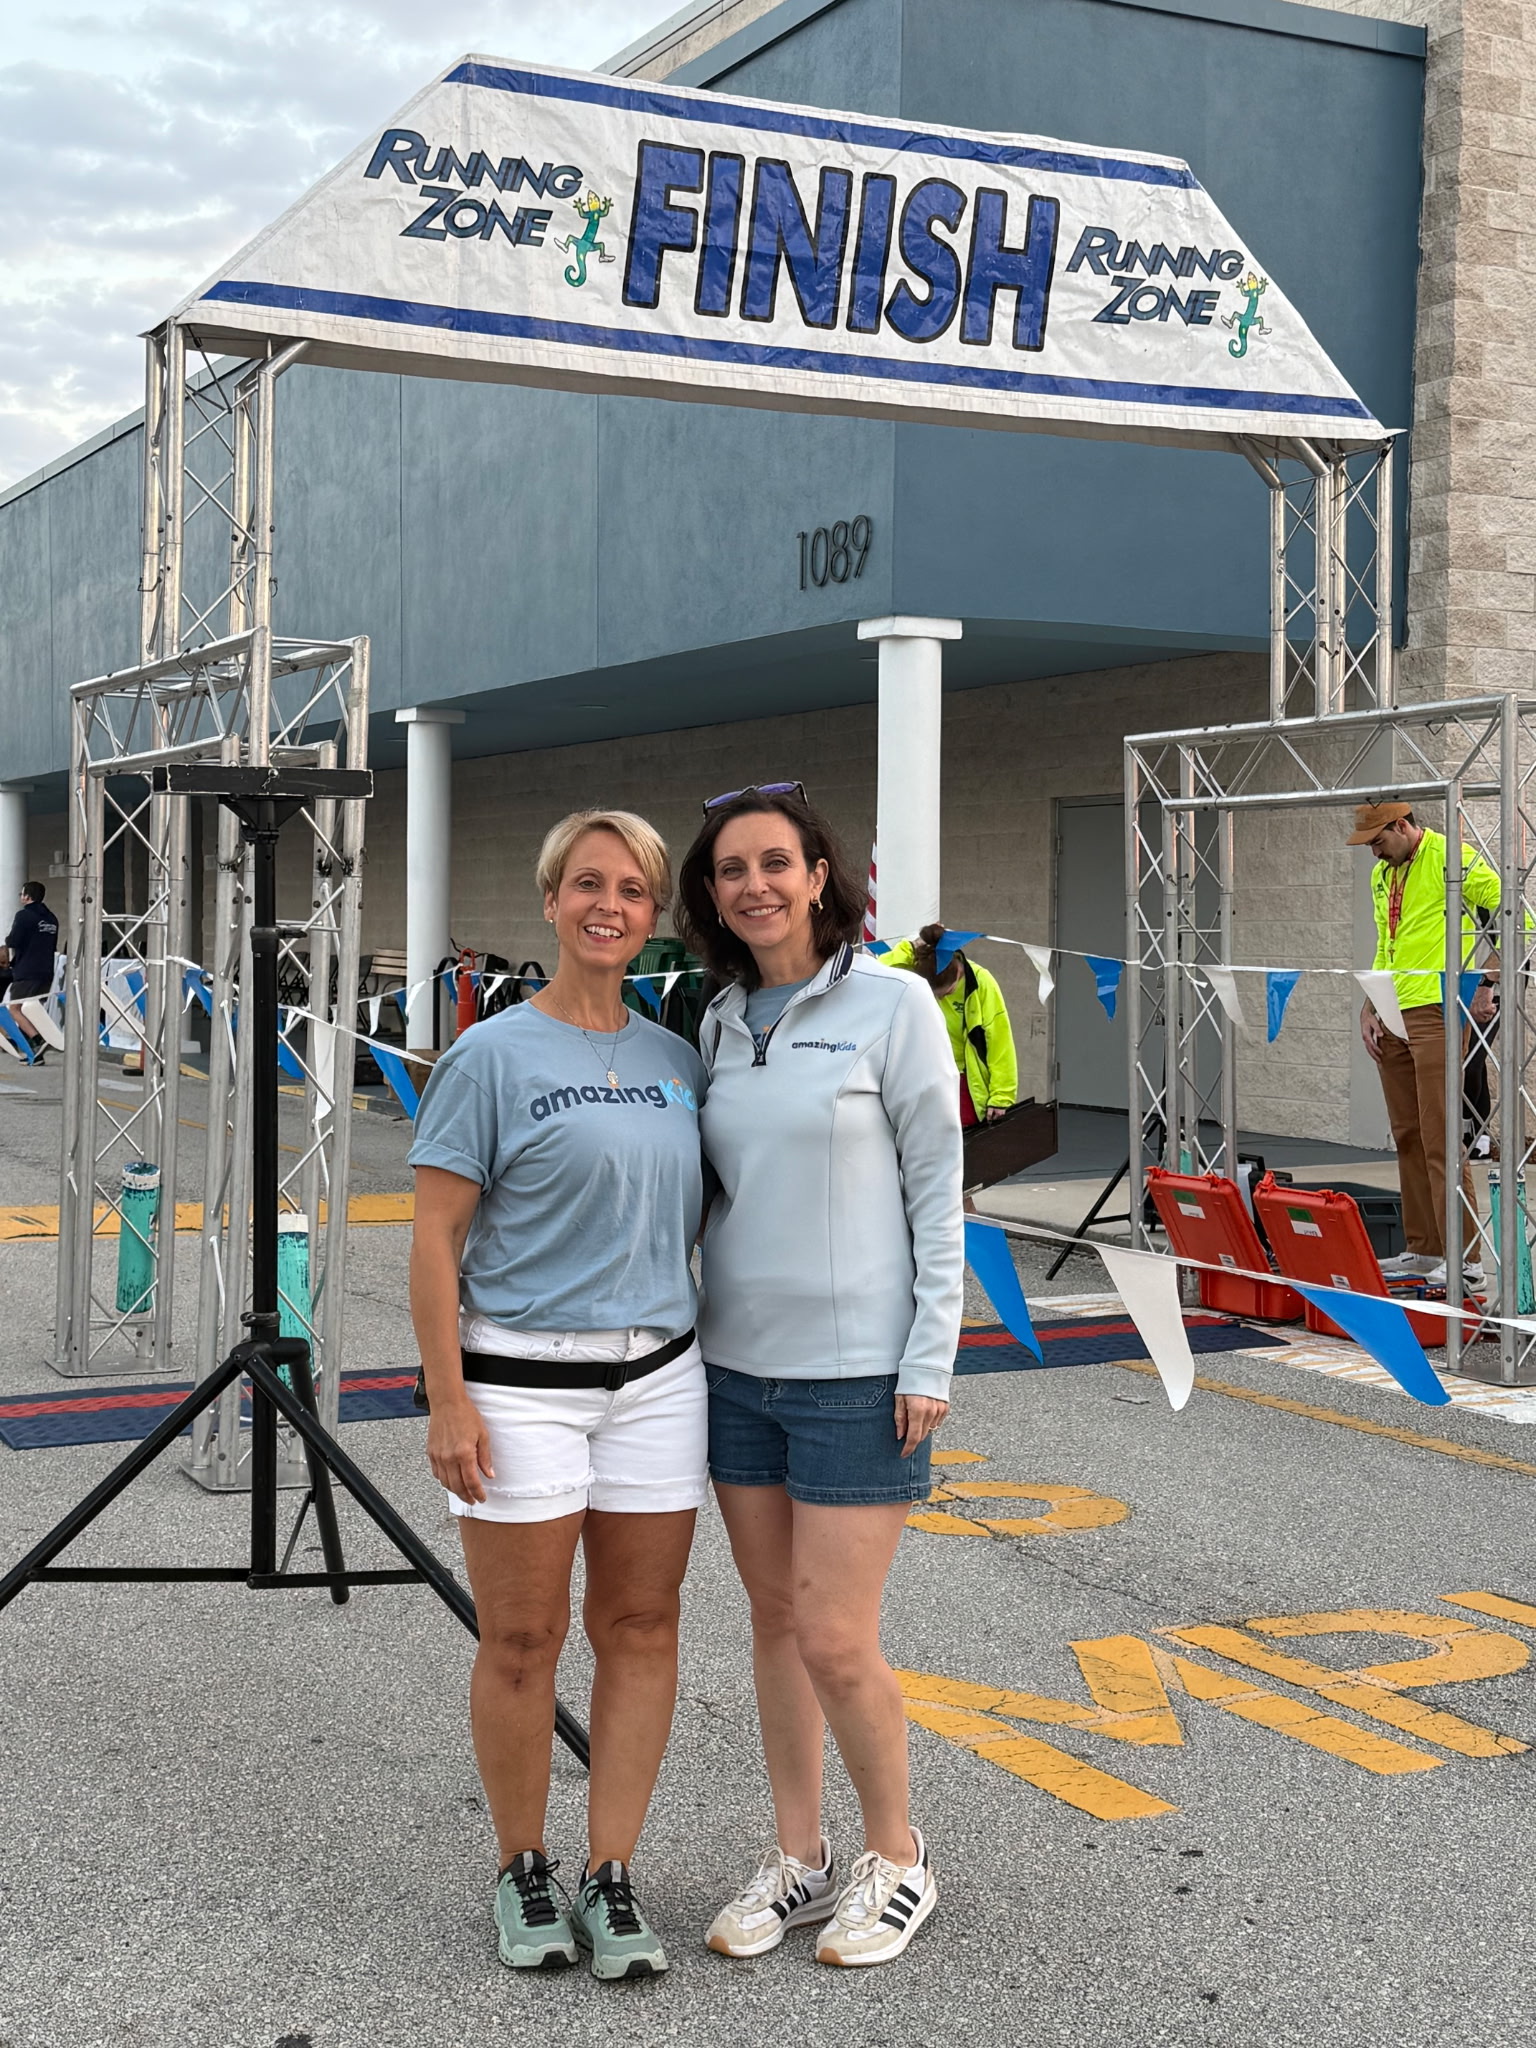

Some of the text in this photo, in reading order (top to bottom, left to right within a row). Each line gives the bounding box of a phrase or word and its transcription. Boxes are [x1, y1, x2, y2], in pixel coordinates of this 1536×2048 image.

[363, 128, 585, 199] RUNNING
[400, 186, 554, 247] ZONE
[621, 138, 1061, 353] FINISH
[1065, 226, 1244, 281] RUNNING
[1091, 276, 1221, 325] ZONE
[796, 514, 871, 592] 1089
[892, 1590, 1536, 1821] MP
